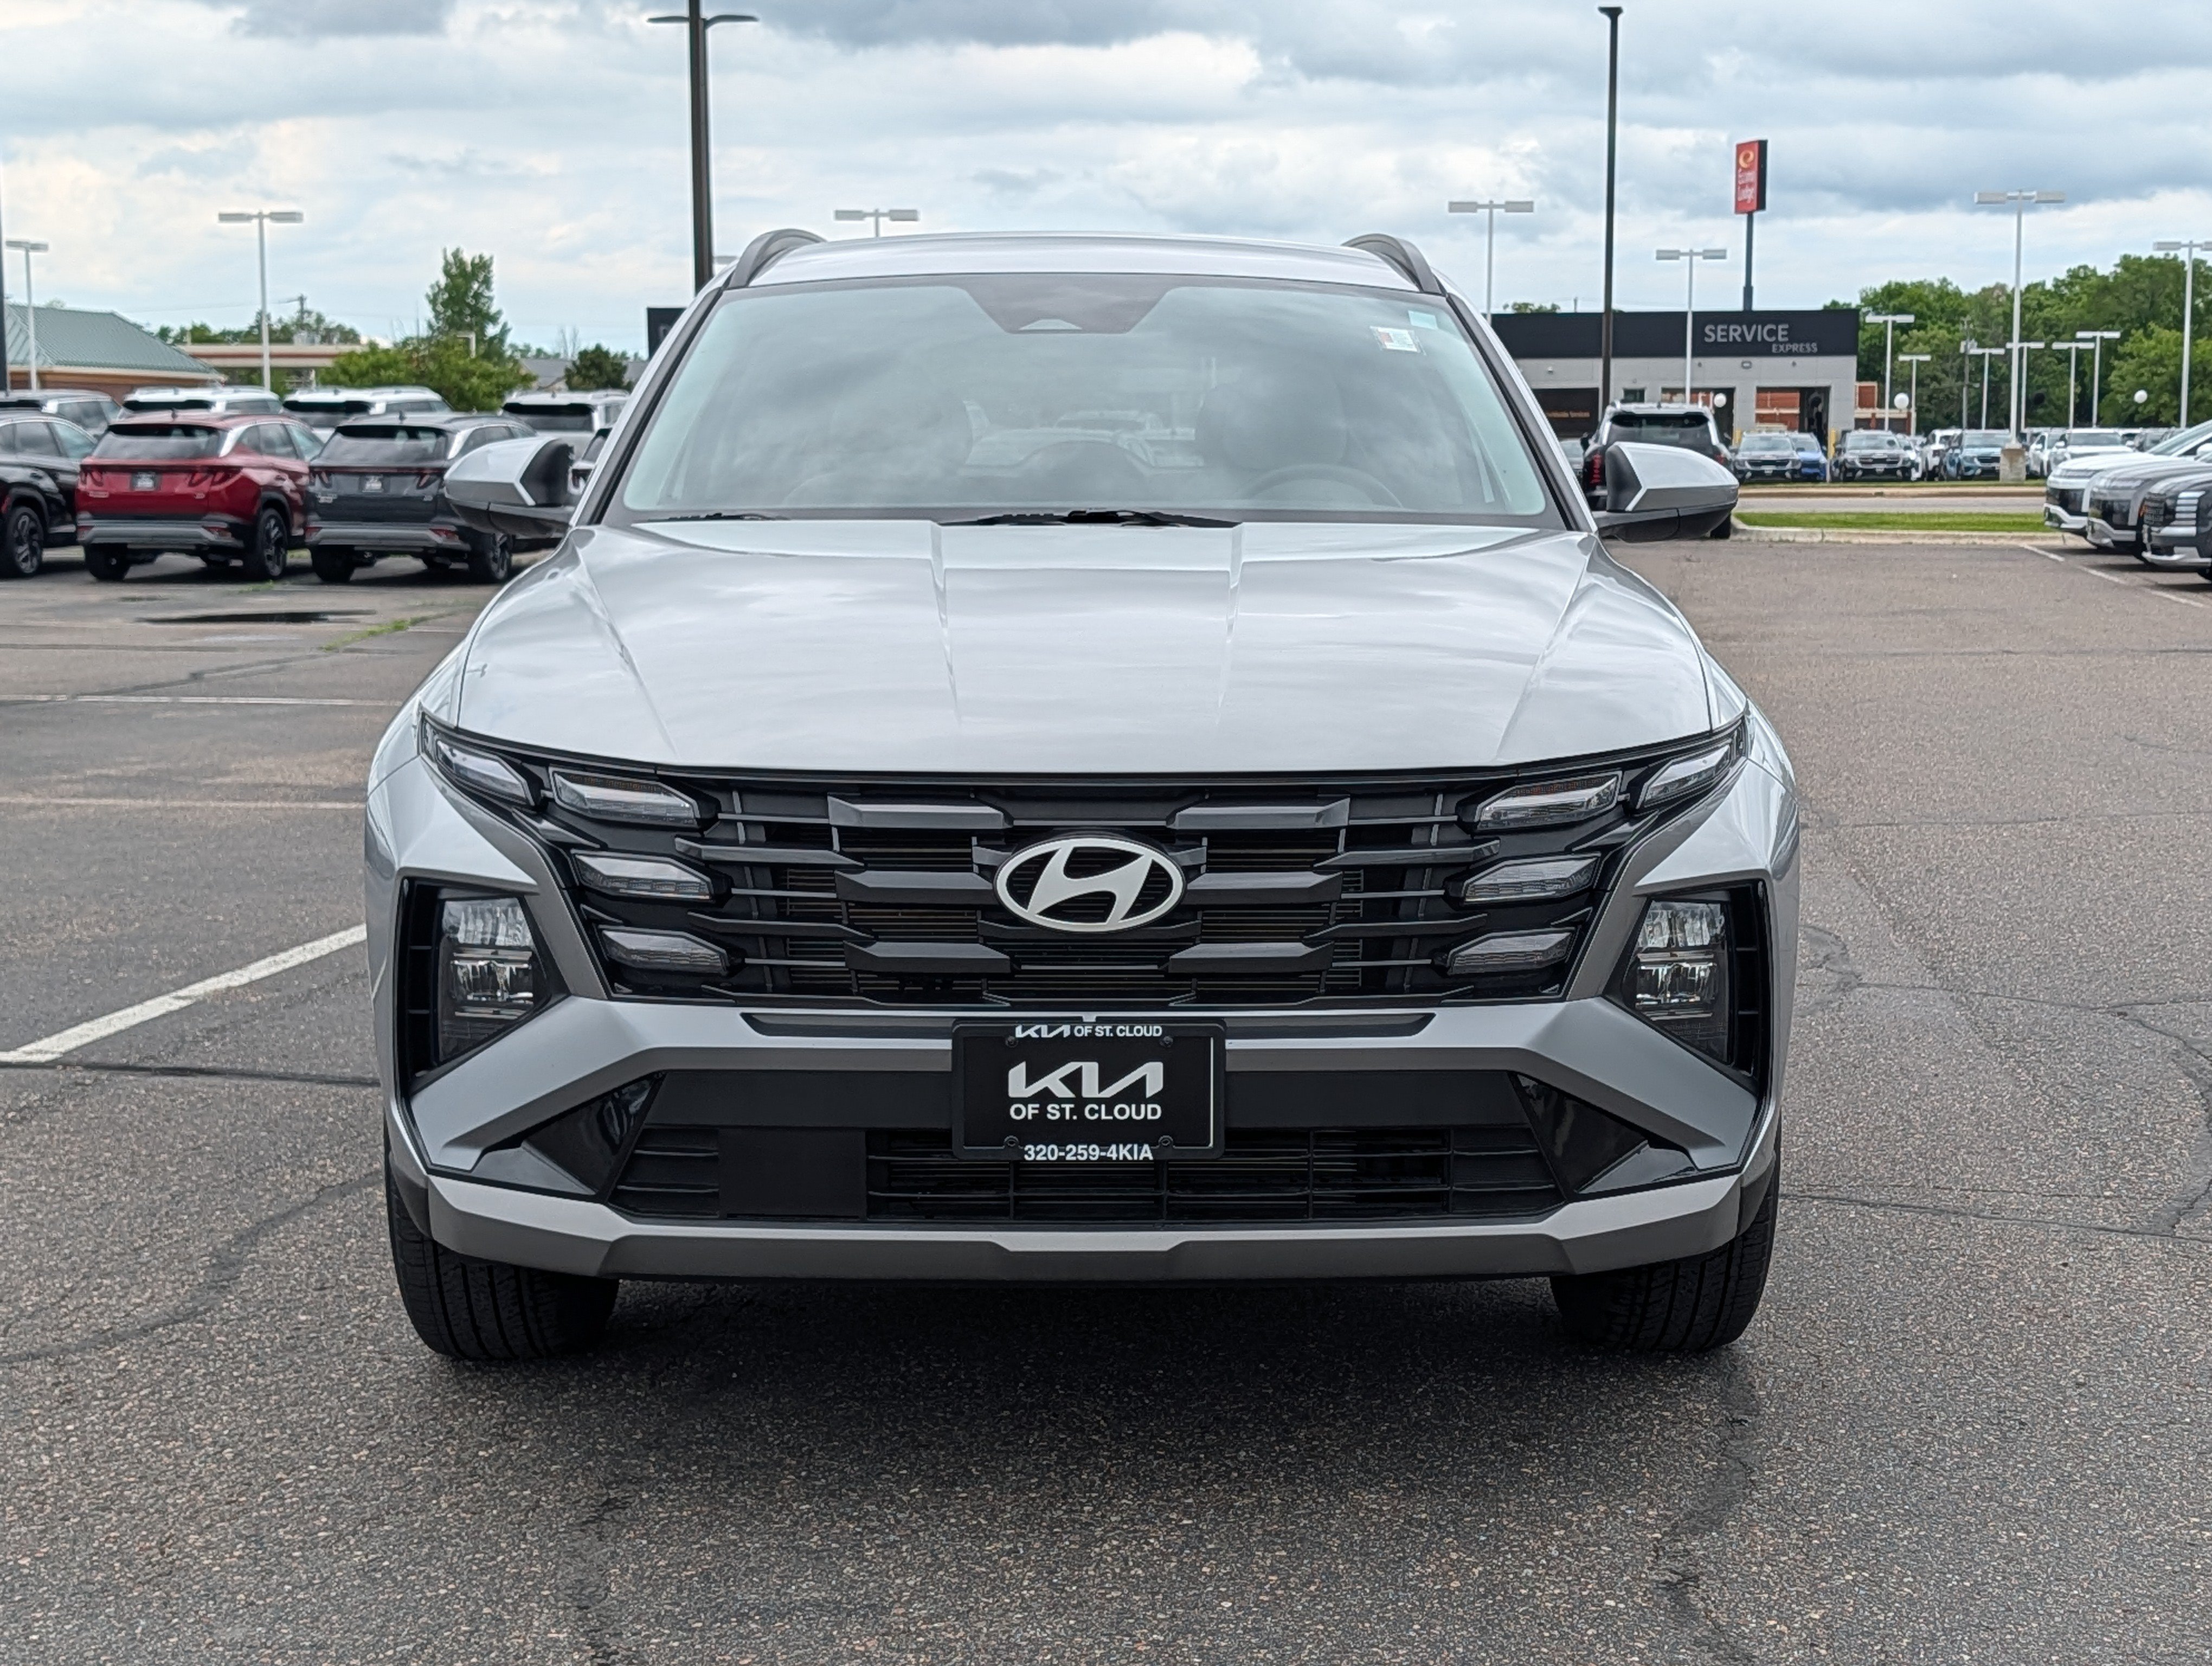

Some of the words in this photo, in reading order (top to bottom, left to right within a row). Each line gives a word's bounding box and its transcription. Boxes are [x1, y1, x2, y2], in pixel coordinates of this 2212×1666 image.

[1704, 324, 1789, 343] SERVICE
[1772, 342, 1818, 353] EXPRESS
[1015, 1024, 1071, 1038] KIA
[1073, 1025, 1093, 1037] OF
[1095, 1025, 1114, 1037] ST.
[1116, 1025, 1163, 1037] CLOUD
[1008, 1061, 1164, 1099] KIA
[1009, 1104, 1040, 1120] OF
[1046, 1104, 1077, 1120] ST.
[1084, 1104, 1162, 1120] CLOUD
[1024, 1144, 1154, 1161] 320-259-4KIA
